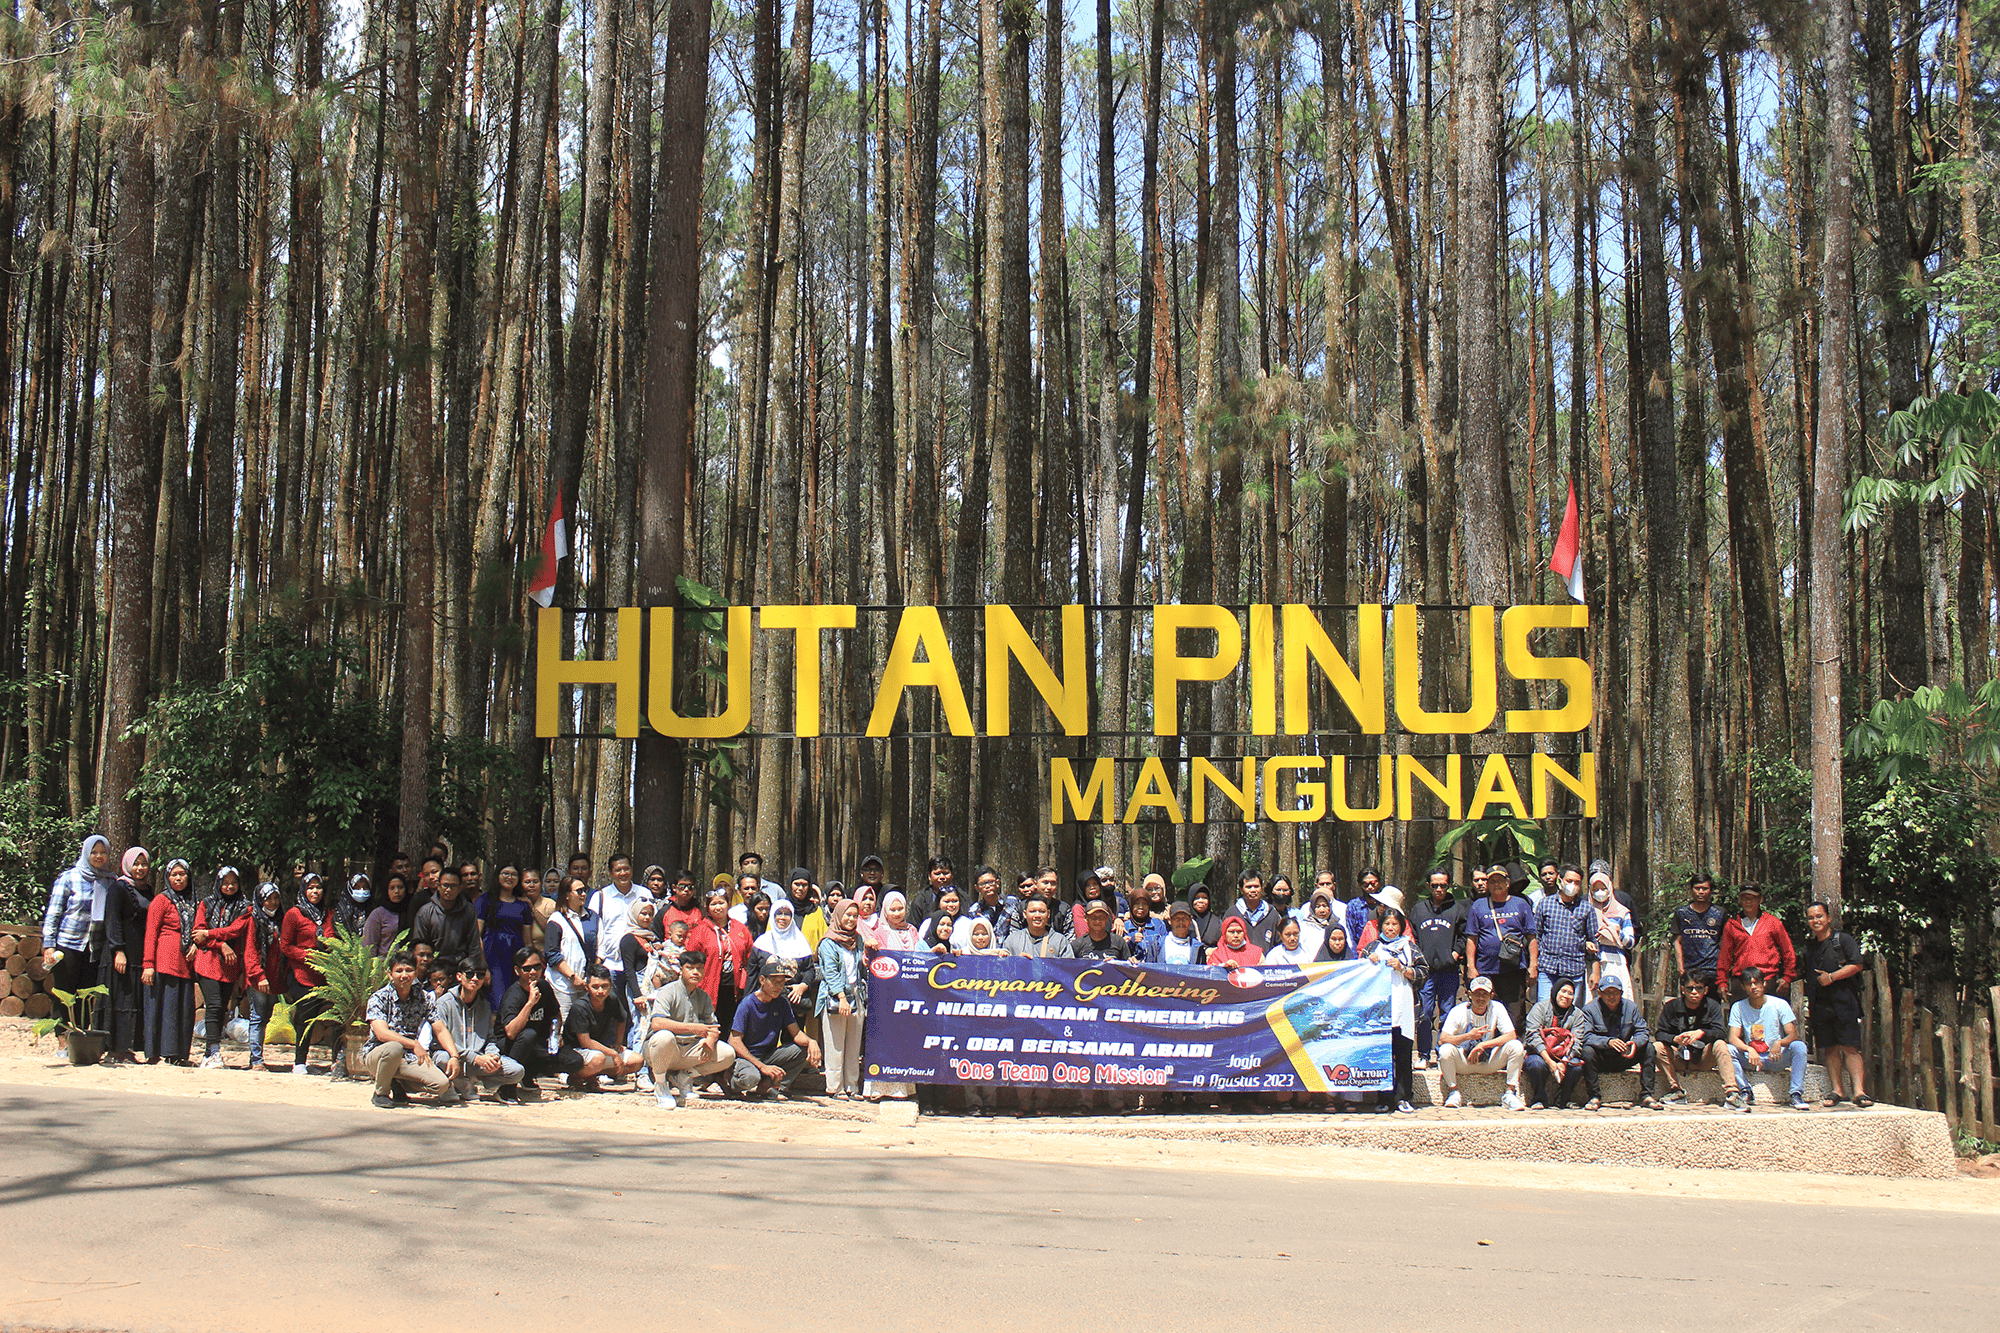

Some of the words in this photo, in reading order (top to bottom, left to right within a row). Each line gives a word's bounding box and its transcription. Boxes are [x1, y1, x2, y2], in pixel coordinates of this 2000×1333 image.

[536, 603, 1089, 739] HUTAN
[1152, 602, 1594, 736] PINUS
[1050, 750, 1598, 825] MANGUNAN
[872, 962, 897, 973] OBA
[901, 965, 929, 973] Bersama
[928, 961, 1065, 1000] Company
[1073, 969, 1221, 1005] Gathering
[893, 1000, 930, 1015] PT.
[935, 1001, 1008, 1018] NIAGA
[1013, 1004, 1100, 1021] GARAM
[1104, 1008, 1246, 1025] CEMERLANG
[1063, 1025, 1073, 1037] &
[923, 1035, 960, 1051] PT.
[966, 1036, 1015, 1052] OBA
[1020, 1039, 1135, 1056] BERSAMA
[1140, 1042, 1214, 1058] ABADI
[882, 1066, 935, 1077] VictoryTour.id
[950, 1058, 995, 1080] "One
[998, 1060, 1048, 1082] Team
[1053, 1062, 1091, 1083] One
[1095, 1064, 1174, 1085] Mission"
[1225, 1054, 1262, 1070] Jogja
[1192, 1074, 1205, 1087] 19
[1208, 1074, 1261, 1089] Agustus
[1263, 1074, 1295, 1088] 2023
